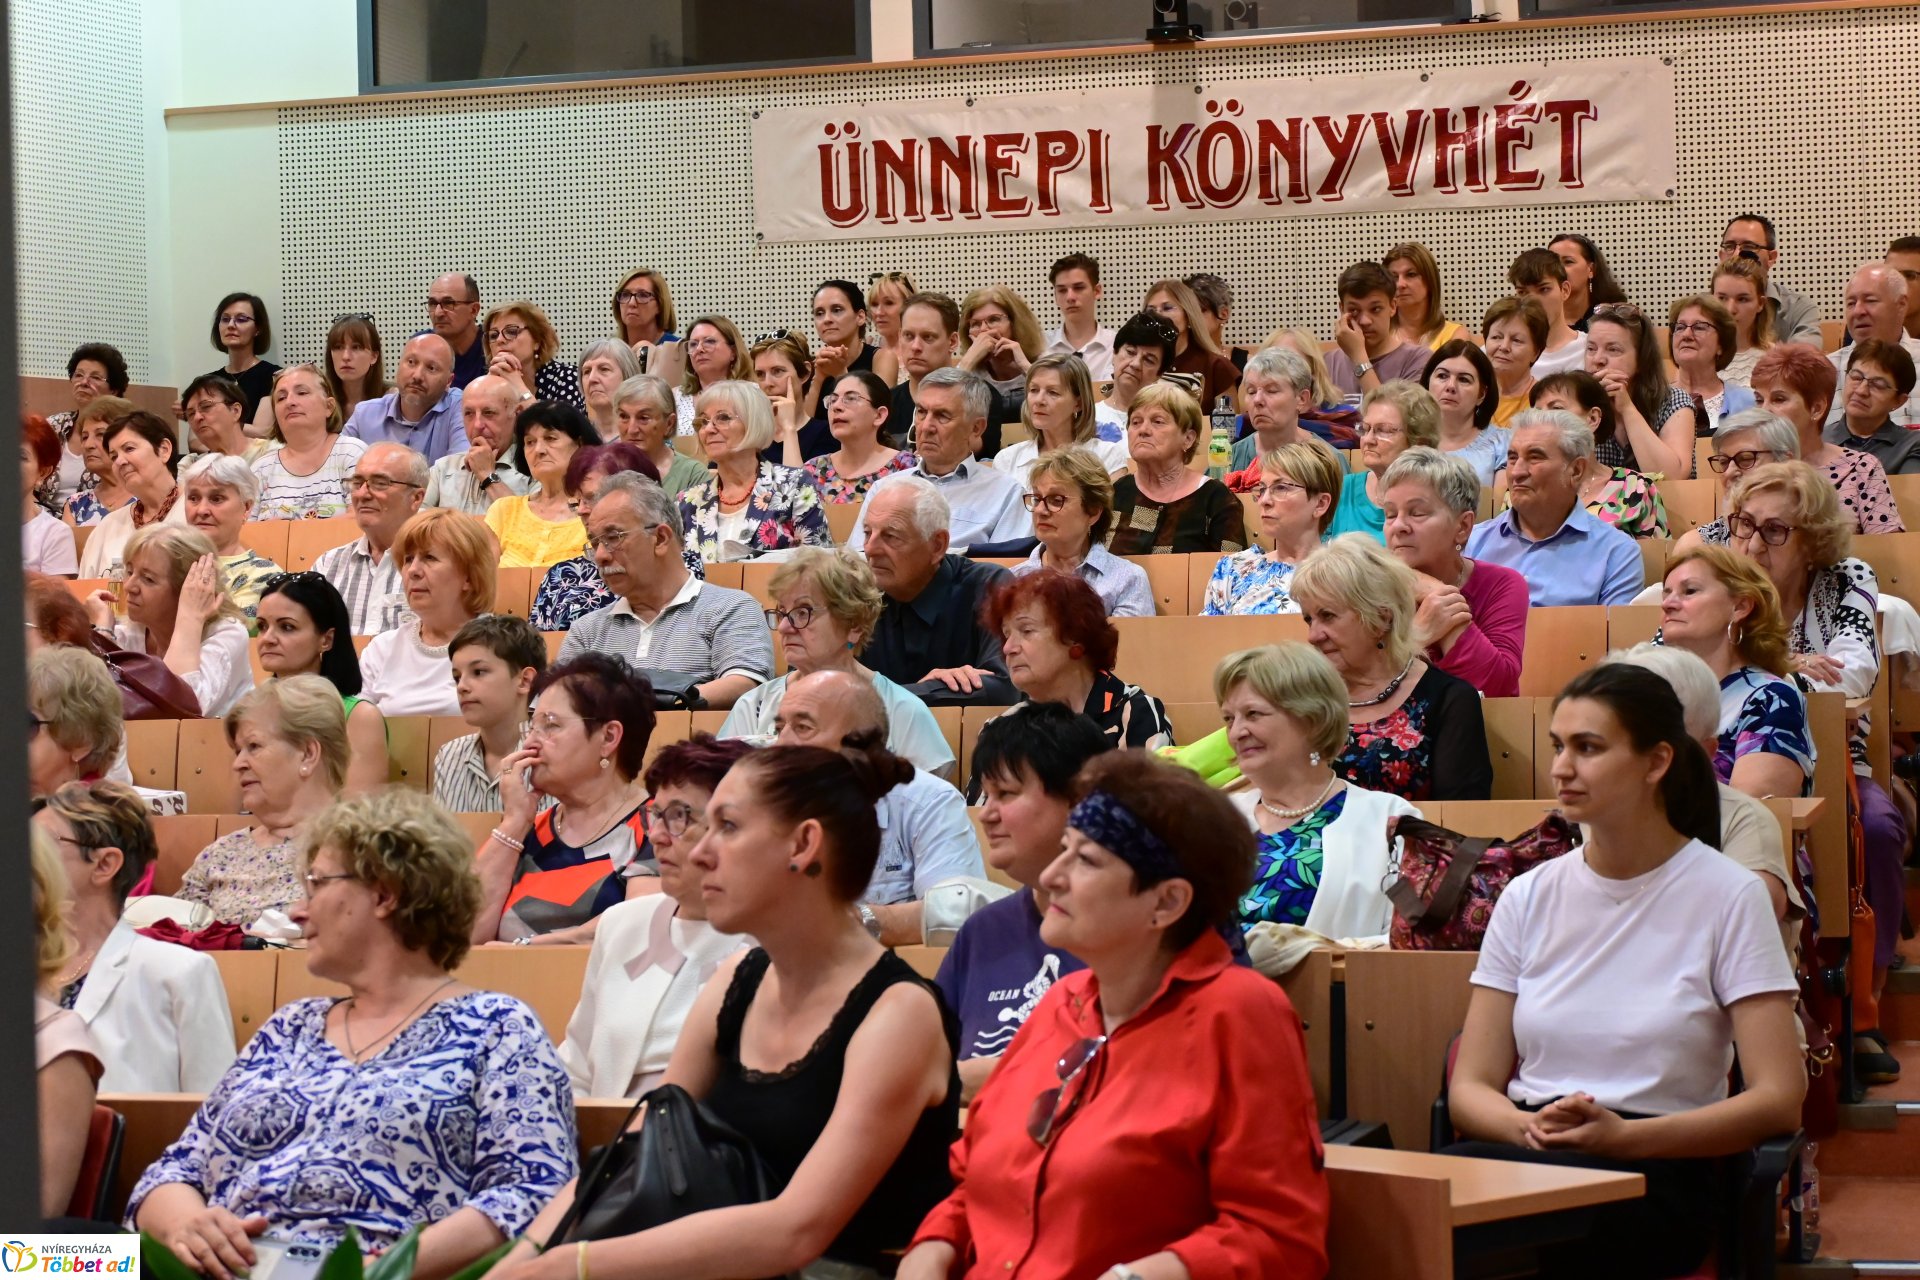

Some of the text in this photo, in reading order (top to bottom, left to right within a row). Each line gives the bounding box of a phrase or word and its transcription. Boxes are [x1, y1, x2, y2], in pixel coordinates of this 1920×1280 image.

[817, 80, 1598, 228] ÜNNEPI KÖNYVHÉT
[988, 989, 1020, 1002] OCEAN
